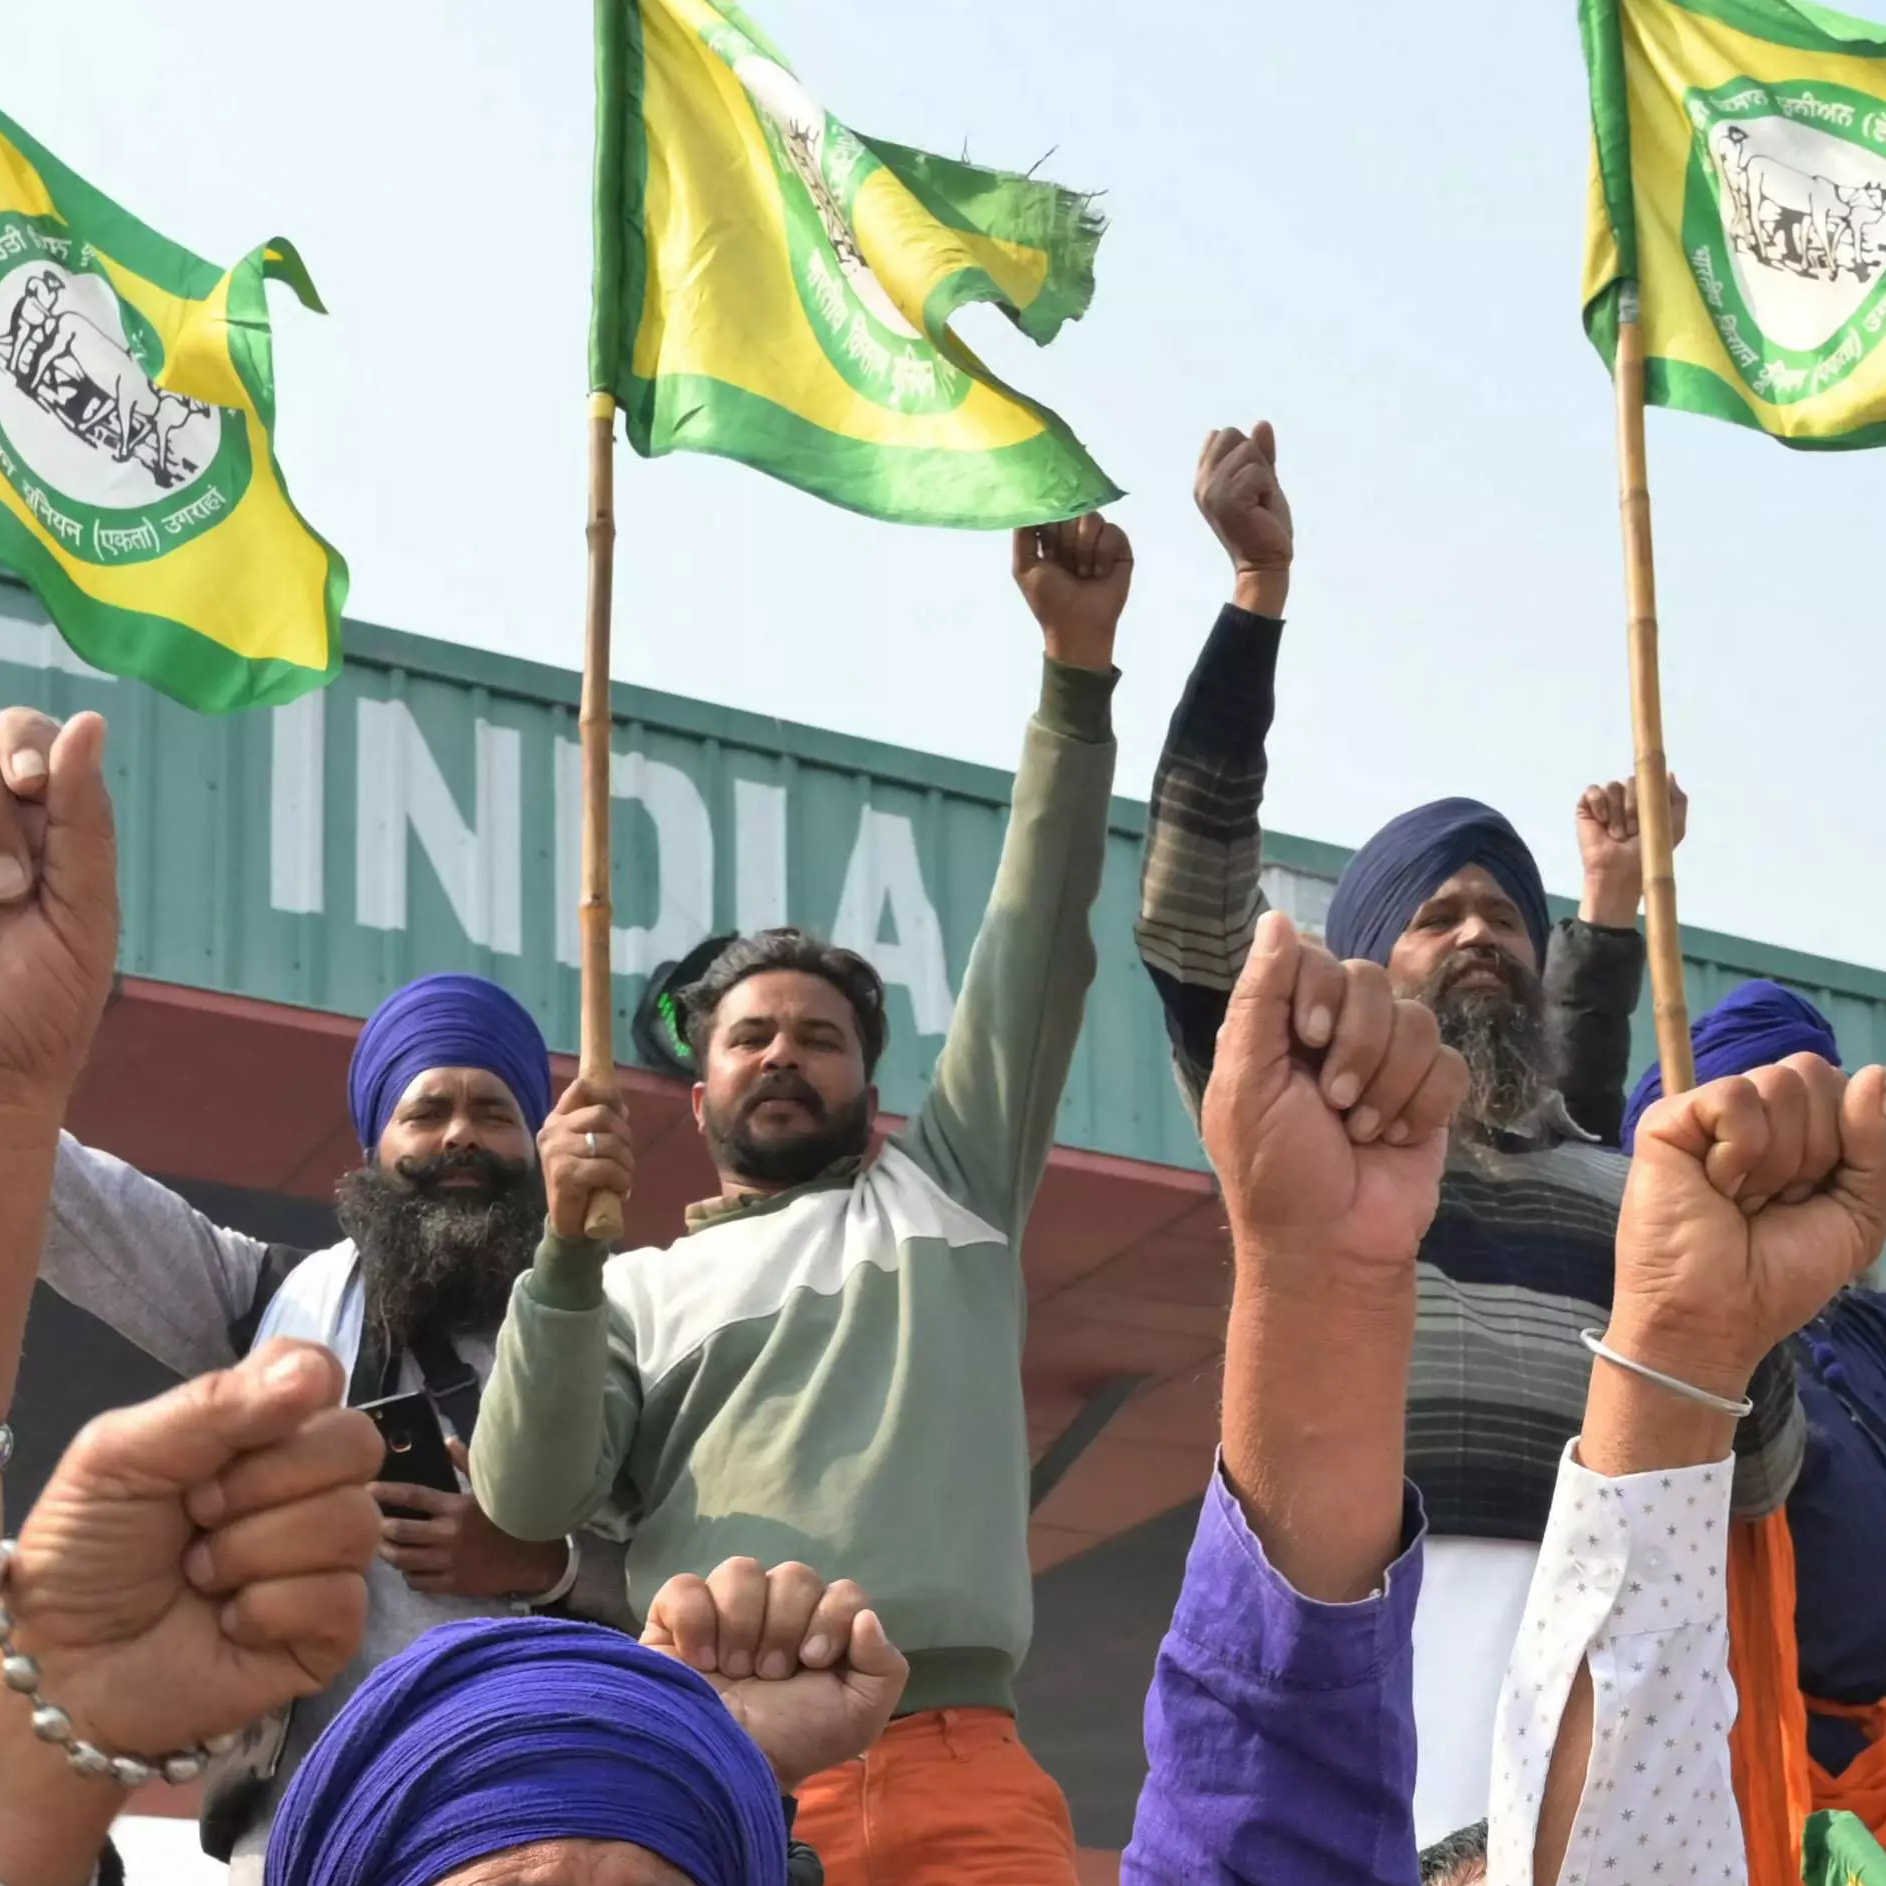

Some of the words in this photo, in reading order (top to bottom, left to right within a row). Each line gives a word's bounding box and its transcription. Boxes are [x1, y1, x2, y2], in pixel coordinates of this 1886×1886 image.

[92, 518, 161, 560] (एकता)
[161, 484, 227, 535] उगराहां
[270, 690, 958, 1036] INDIA
